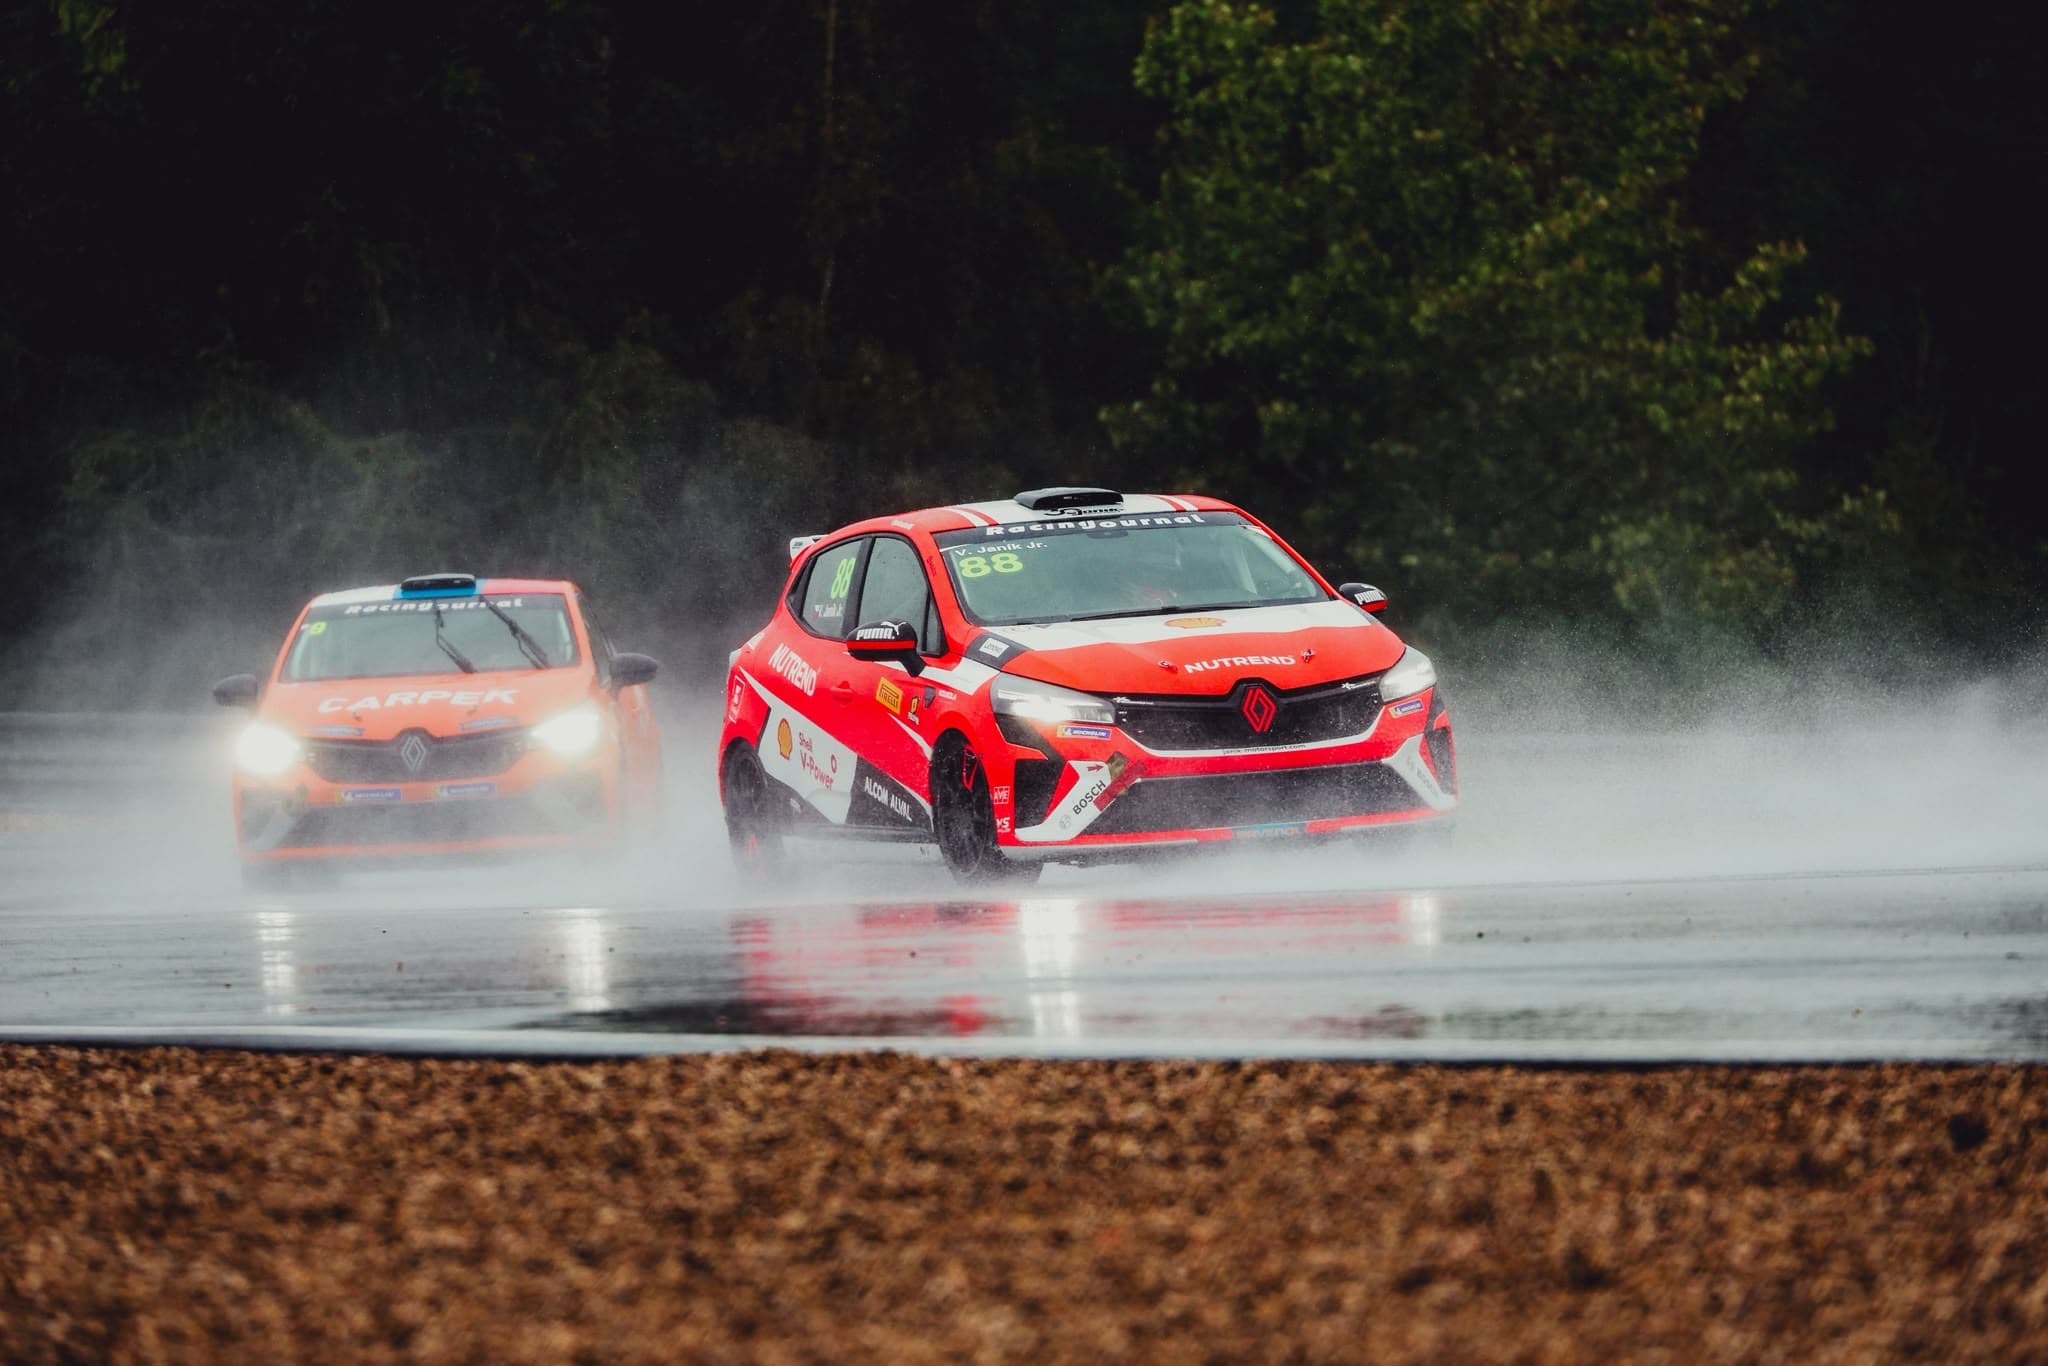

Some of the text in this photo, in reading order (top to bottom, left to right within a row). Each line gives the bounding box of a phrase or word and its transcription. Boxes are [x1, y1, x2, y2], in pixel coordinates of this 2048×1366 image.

[1025, 540, 1048, 551] Jr.
[830, 557, 857, 600] 88
[958, 552, 1024, 579] 88
[768, 642, 817, 697] NUTREND
[1184, 655, 1296, 673] NUTREND
[317, 689, 520, 713] CARPEK
[798, 732, 814, 752] Shell
[800, 751, 834, 790] V-Power
[1073, 780, 1106, 815] BOSCH
